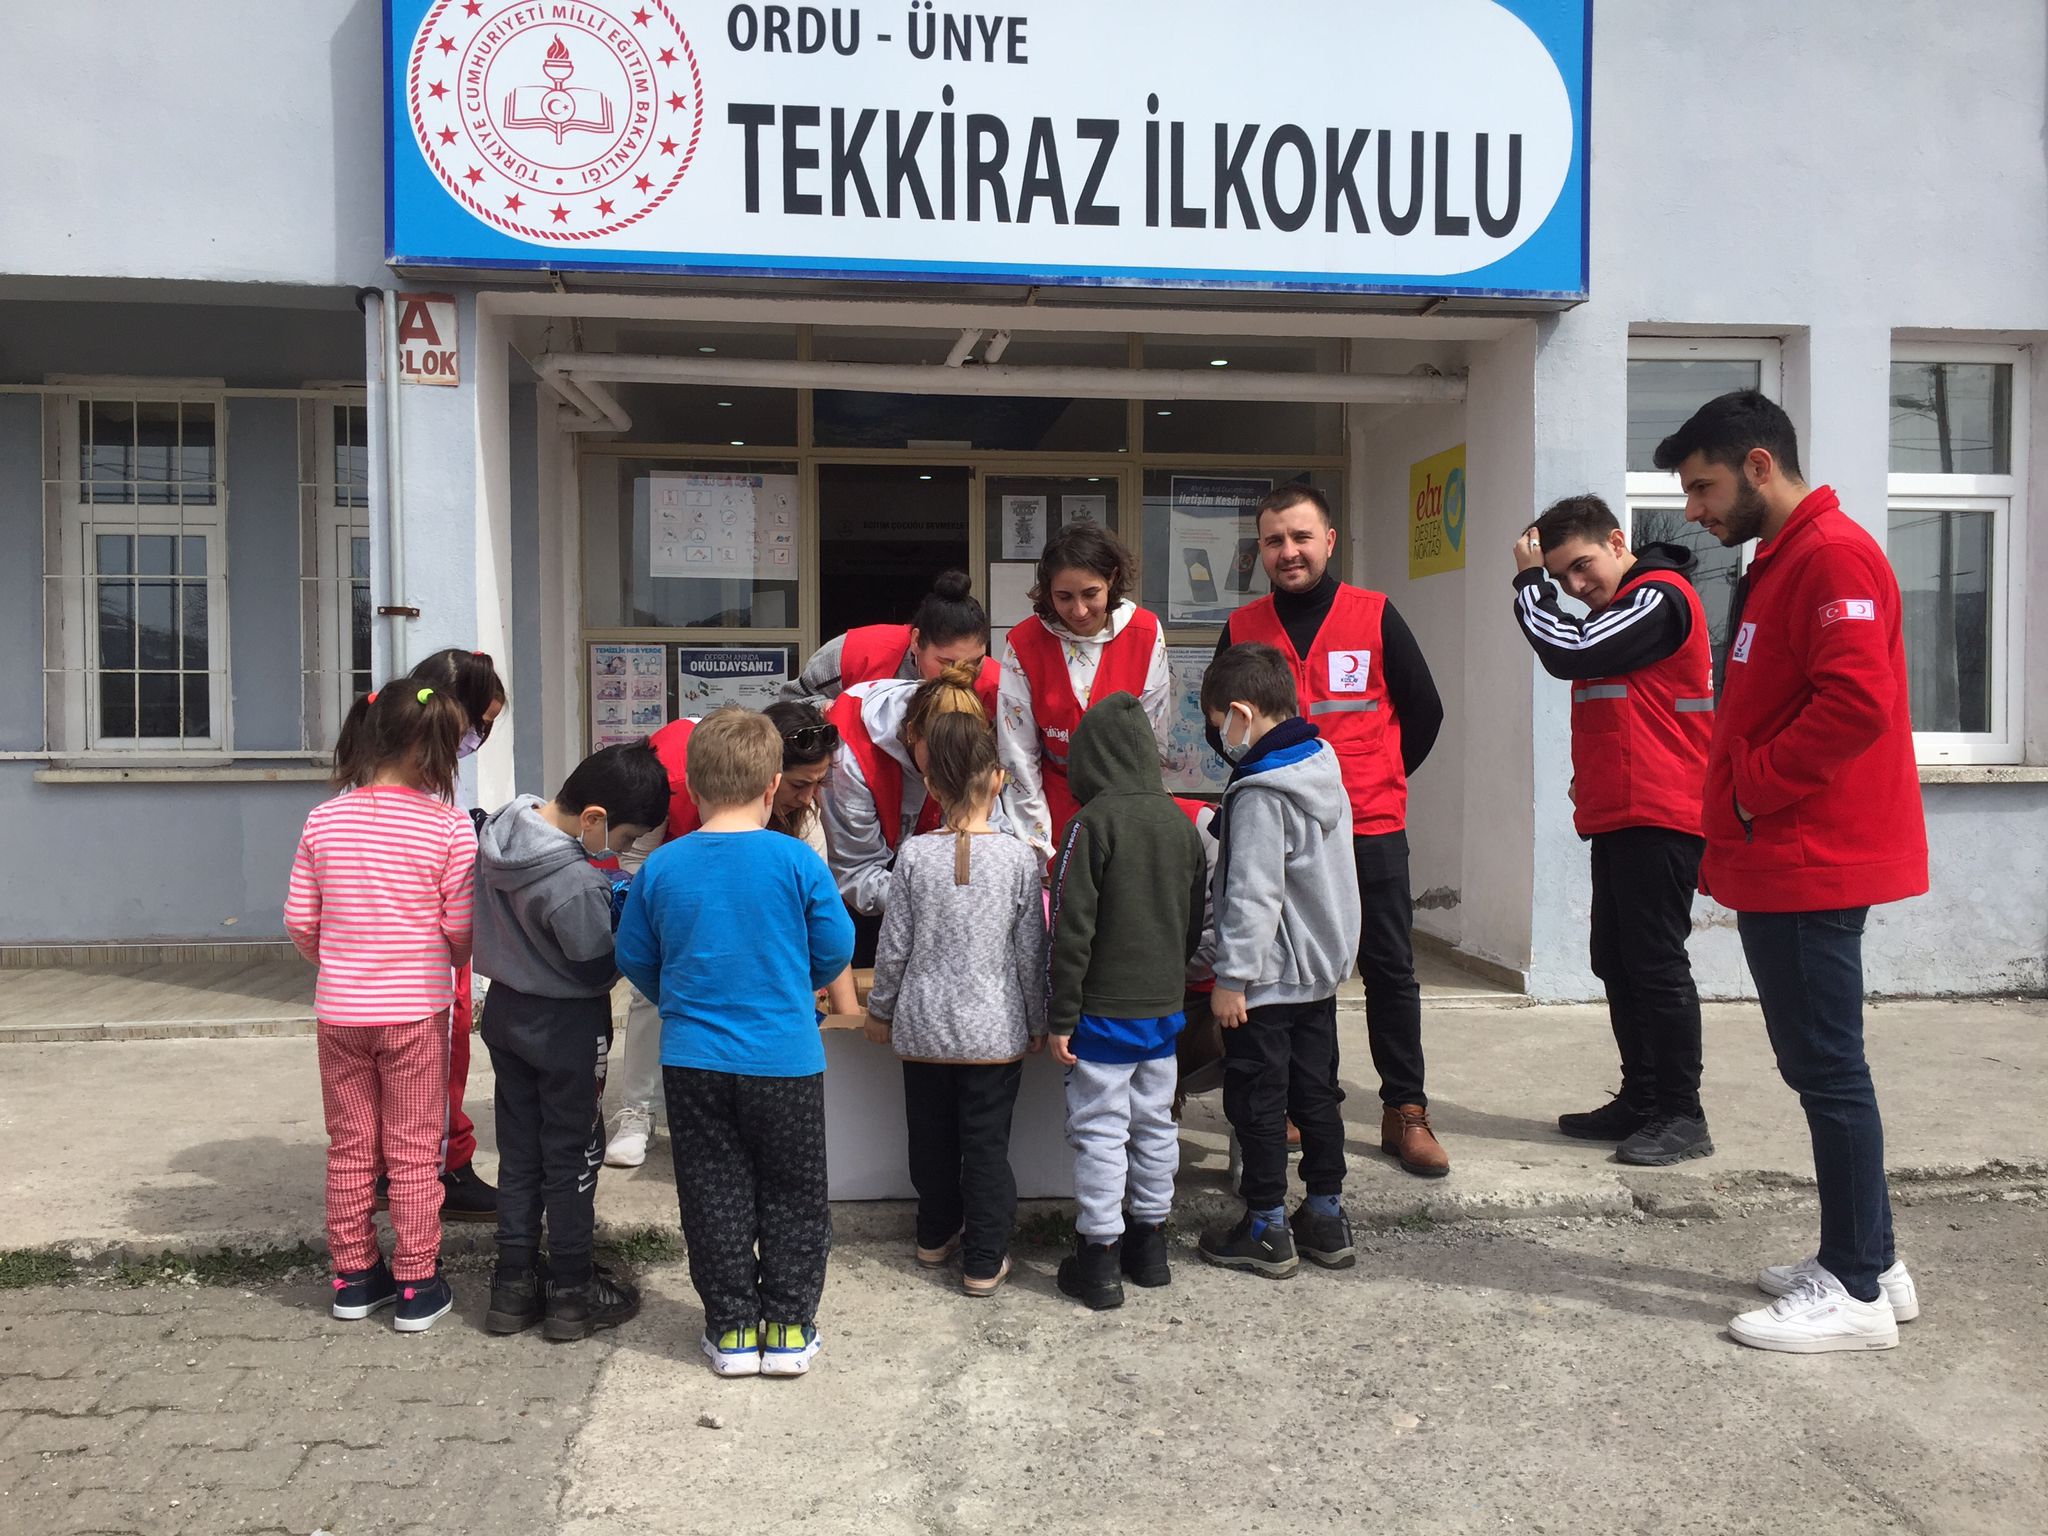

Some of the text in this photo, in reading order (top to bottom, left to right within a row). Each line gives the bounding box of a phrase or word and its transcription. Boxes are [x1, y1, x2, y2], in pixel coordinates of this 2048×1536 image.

[466, 3, 544, 112] CUMHURİYETİ
[607, 29, 649, 93] EĞİTİM
[727, 4, 861, 55] ORDU
[907, 1, 1028, 64] ÜNYE
[472, 118, 539, 183] TÜRKİYE
[582, 101, 650, 184] BAKANLIĞI
[727, 84, 1522, 239] TEKKİRAZ İLKOKULU
[399, 301, 442, 346] A
[1179, 492, 1213, 506] İletişim
[690, 661, 774, 672] OKULDAYSANIZ
